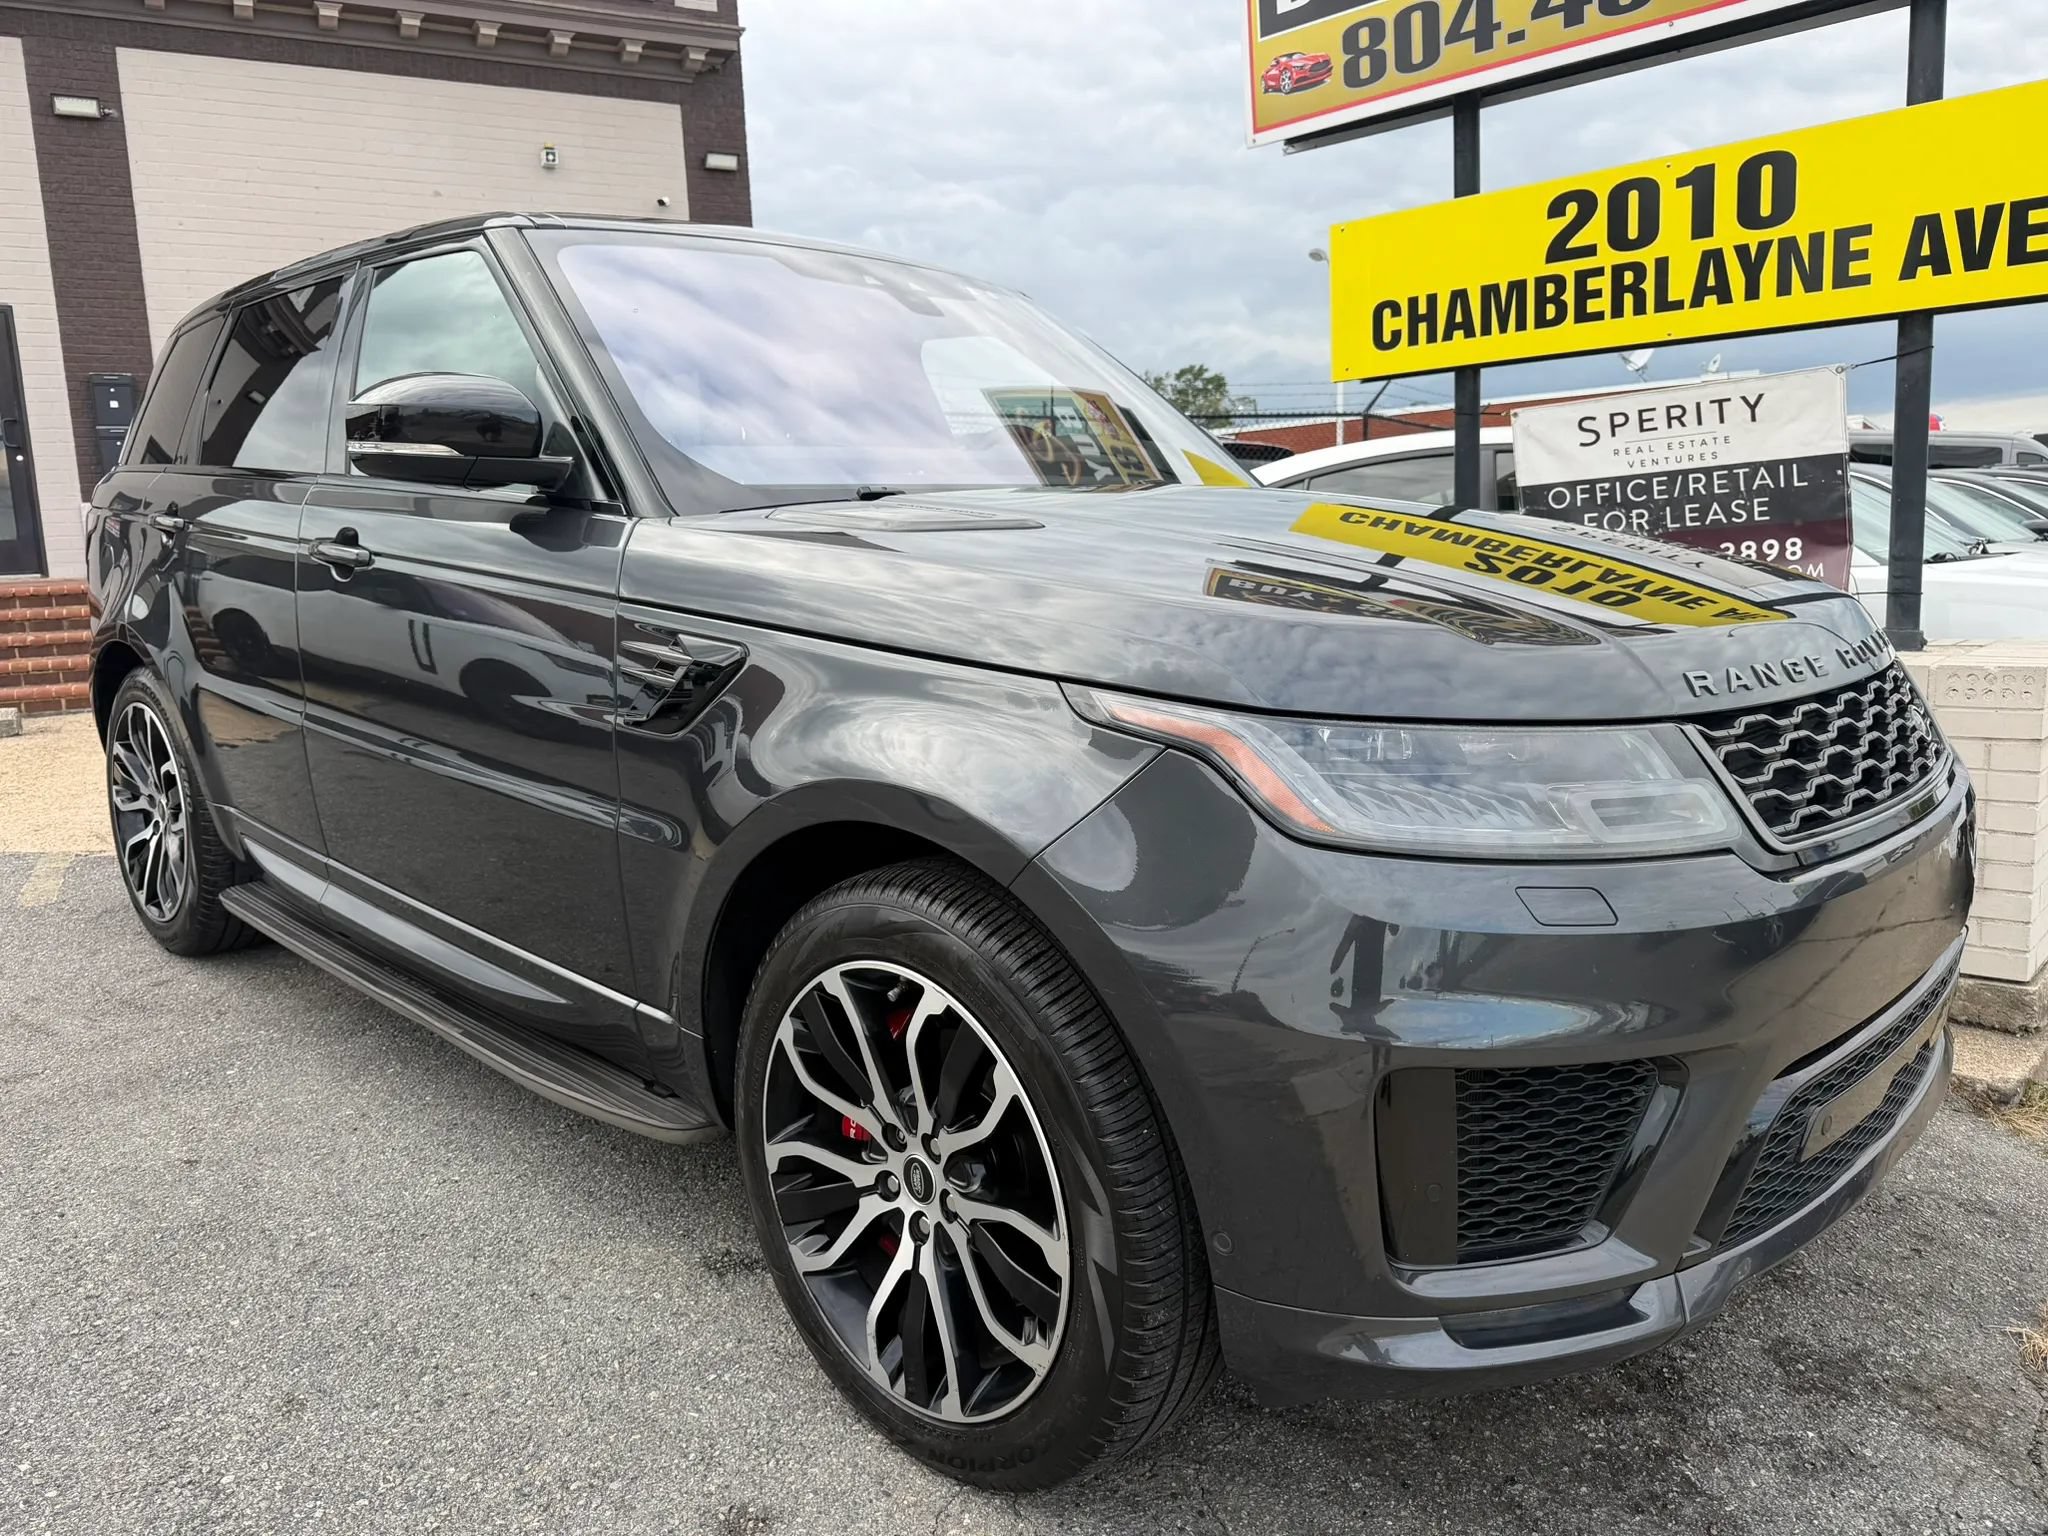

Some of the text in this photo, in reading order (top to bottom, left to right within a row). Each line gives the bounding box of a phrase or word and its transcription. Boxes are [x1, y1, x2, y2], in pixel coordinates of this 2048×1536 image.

[1545, 150, 1797, 265] 2010
[1372, 196, 2048, 352] CHAMBERLAYNE AVE
[1577, 393, 1765, 447] SPERITY
[1613, 435, 1732, 457] REAL ESTATE
[1627, 451, 1719, 469] VENTURES
[1548, 463, 1809, 510] OFFICE/RETAIL
[1584, 497, 1771, 532] FOR LEASE
[1682, 654, 1829, 698] RANGE
